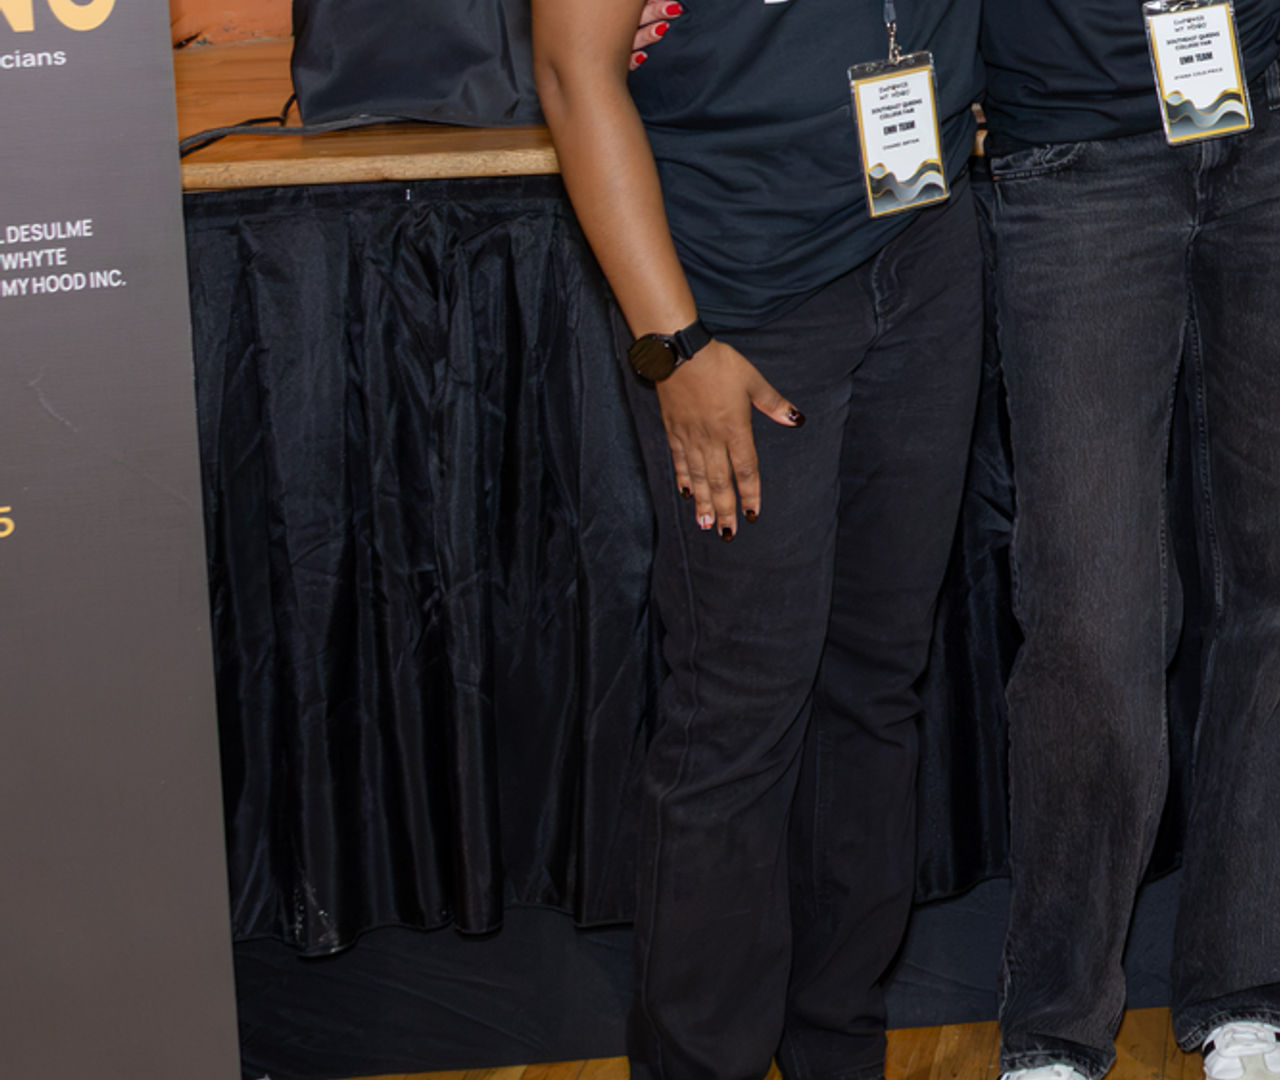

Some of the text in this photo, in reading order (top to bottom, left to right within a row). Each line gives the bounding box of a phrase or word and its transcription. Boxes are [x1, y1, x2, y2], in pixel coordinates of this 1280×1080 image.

[6, 219, 93, 244] DESULME
[0, 247, 67, 270] WHYTE
[2, 269, 127, 297] MY HOOD INC.
